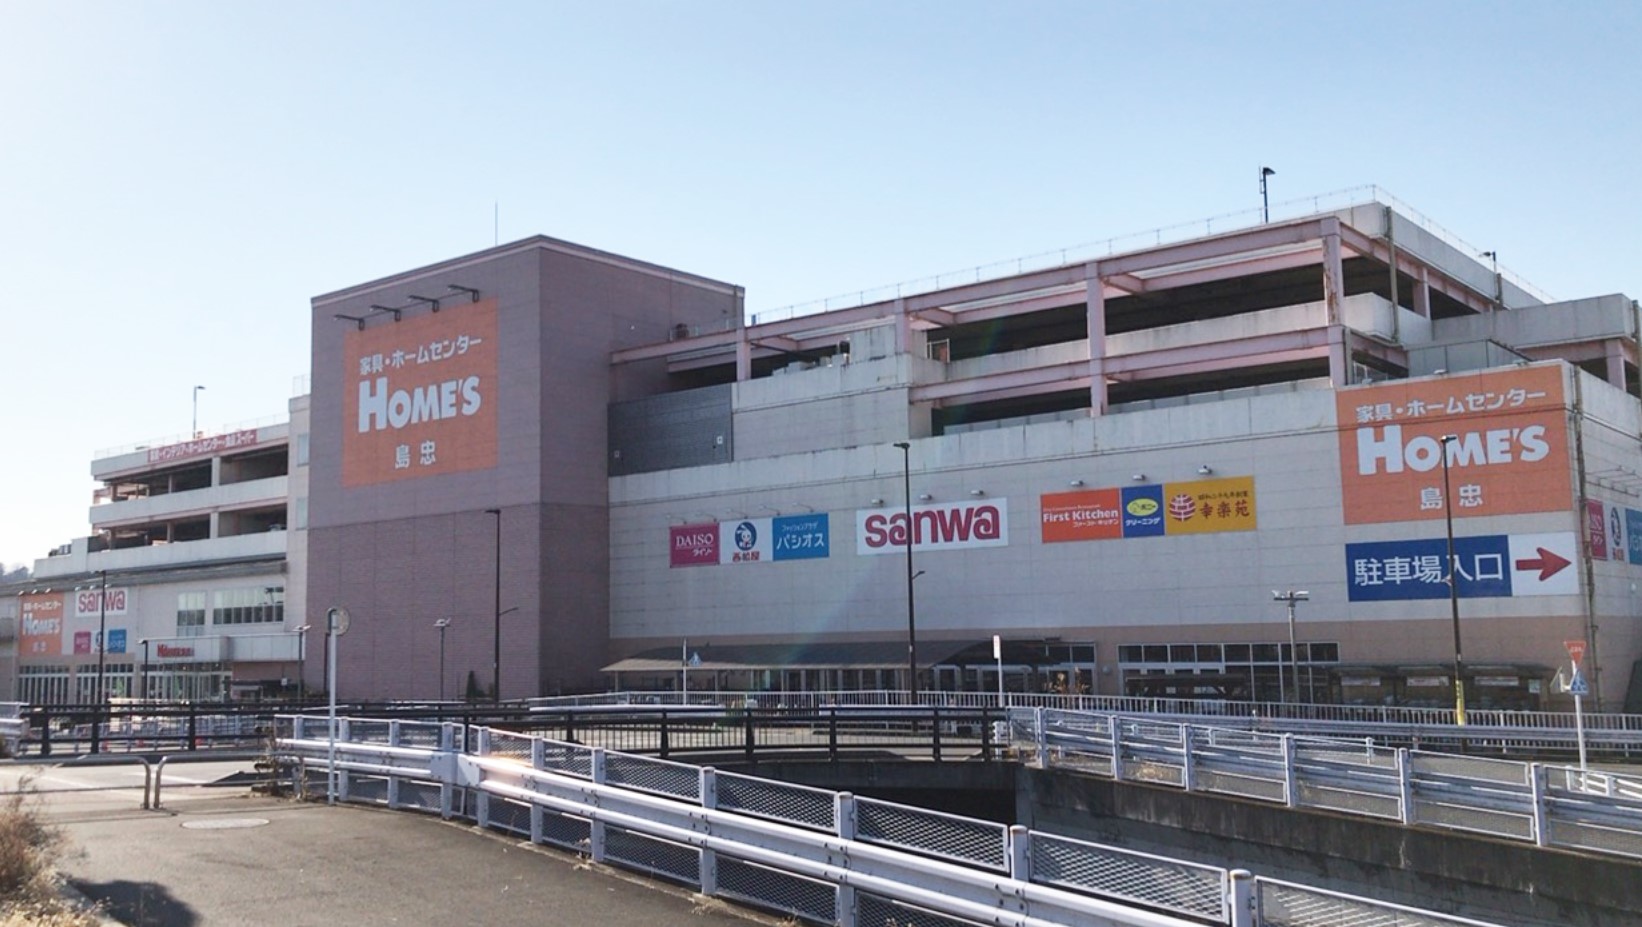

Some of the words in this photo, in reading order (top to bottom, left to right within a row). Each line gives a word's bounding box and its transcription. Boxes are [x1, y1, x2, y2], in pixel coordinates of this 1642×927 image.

[359, 335, 482, 375] 家具・ホームセンター
[358, 376, 482, 433] HOME'S
[1355, 388, 1547, 423] 家具・ホームセンター
[395, 440, 436, 469] 島忠
[1356, 424, 1550, 475] HOME'S
[1420, 484, 1483, 510] 島忠
[864, 503, 1001, 547] sanwa
[1042, 512, 1070, 523] First
[1072, 509, 1119, 521] Kitchen
[676, 533, 714, 548] DAISO
[776, 533, 825, 550] パシオス
[1354, 553, 1503, 586] 駐車場入口
